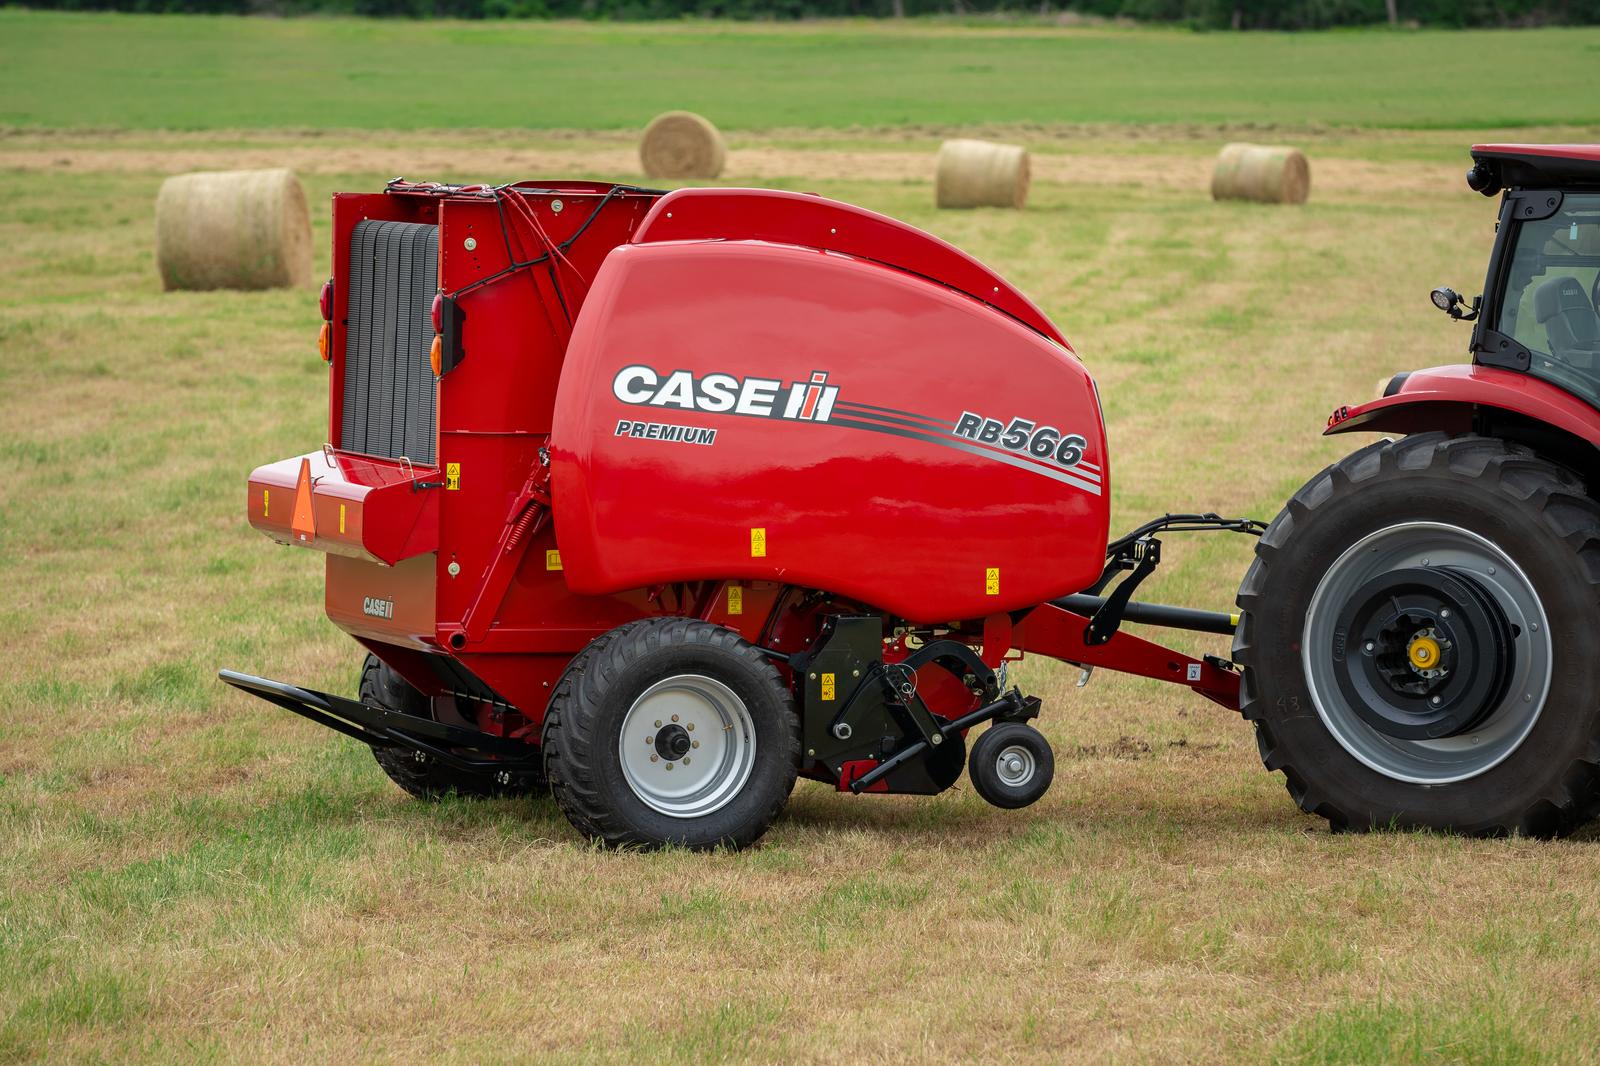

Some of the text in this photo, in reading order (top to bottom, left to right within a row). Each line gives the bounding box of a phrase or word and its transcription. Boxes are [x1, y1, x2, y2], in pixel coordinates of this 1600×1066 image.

[613, 365, 781, 417] CASE
[615, 420, 717, 445] PREMIUM
[952, 410, 1087, 467] RB566
[363, 596, 385, 617] CASE
